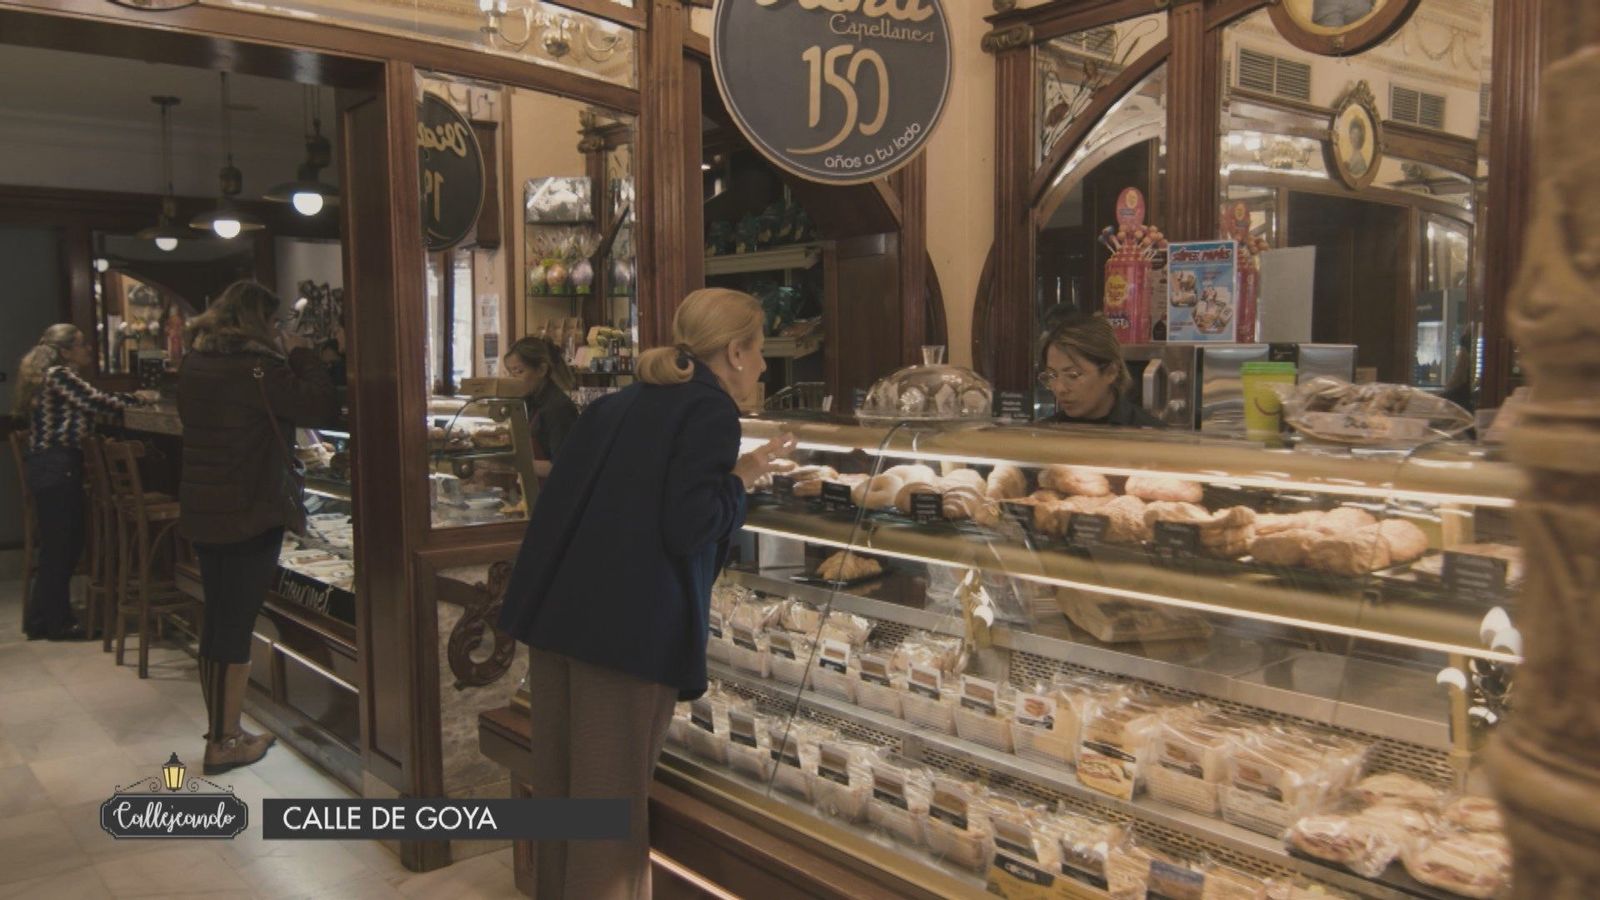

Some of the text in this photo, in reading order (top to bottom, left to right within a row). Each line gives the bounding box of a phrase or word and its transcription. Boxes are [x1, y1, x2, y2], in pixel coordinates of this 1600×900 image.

[829, 13, 934, 43] Capellanes
[786, 44, 890, 154] 150
[824, 123, 920, 168] años a tu lado
